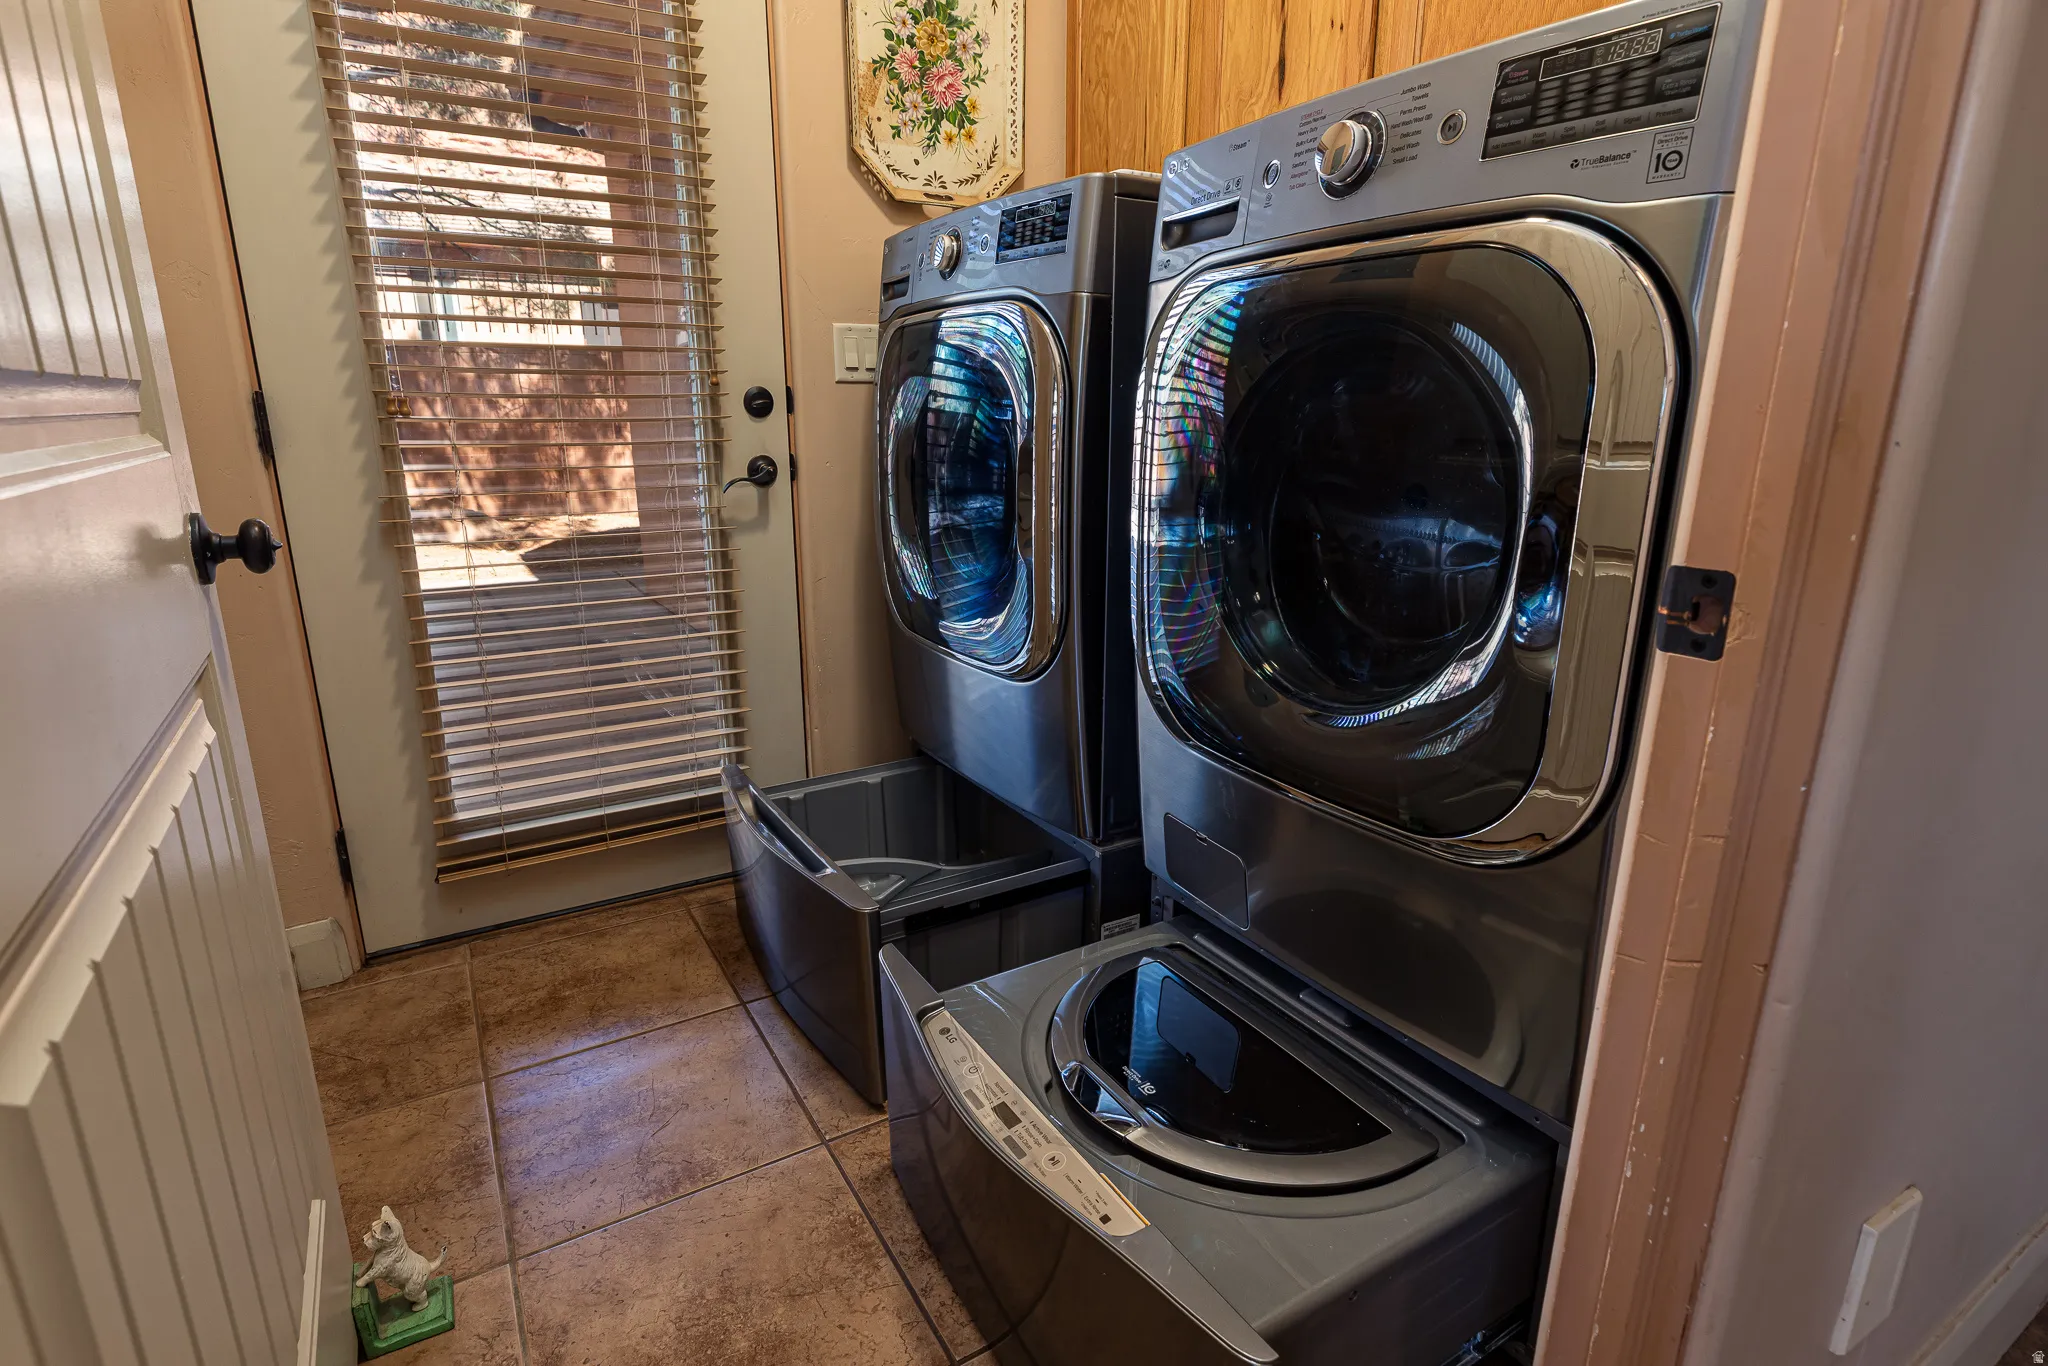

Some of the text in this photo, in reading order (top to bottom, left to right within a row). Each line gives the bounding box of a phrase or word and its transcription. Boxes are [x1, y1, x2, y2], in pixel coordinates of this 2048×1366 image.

[1400, 82, 1432, 95] Jumbo Wash
[1411, 92, 1430, 102] Towels
[1400, 129, 1422, 140] Delicates
[1657, 134, 1688, 145] Direct Drive
[1406, 141, 1420, 150] Wash
[1406, 153, 1419, 162] Load
[1580, 150, 1632, 167] TrueBalance
[1654, 149, 1684, 174] 10
[1190, 194, 1206, 206] Direct
[1206, 190, 1221, 203] Drive
